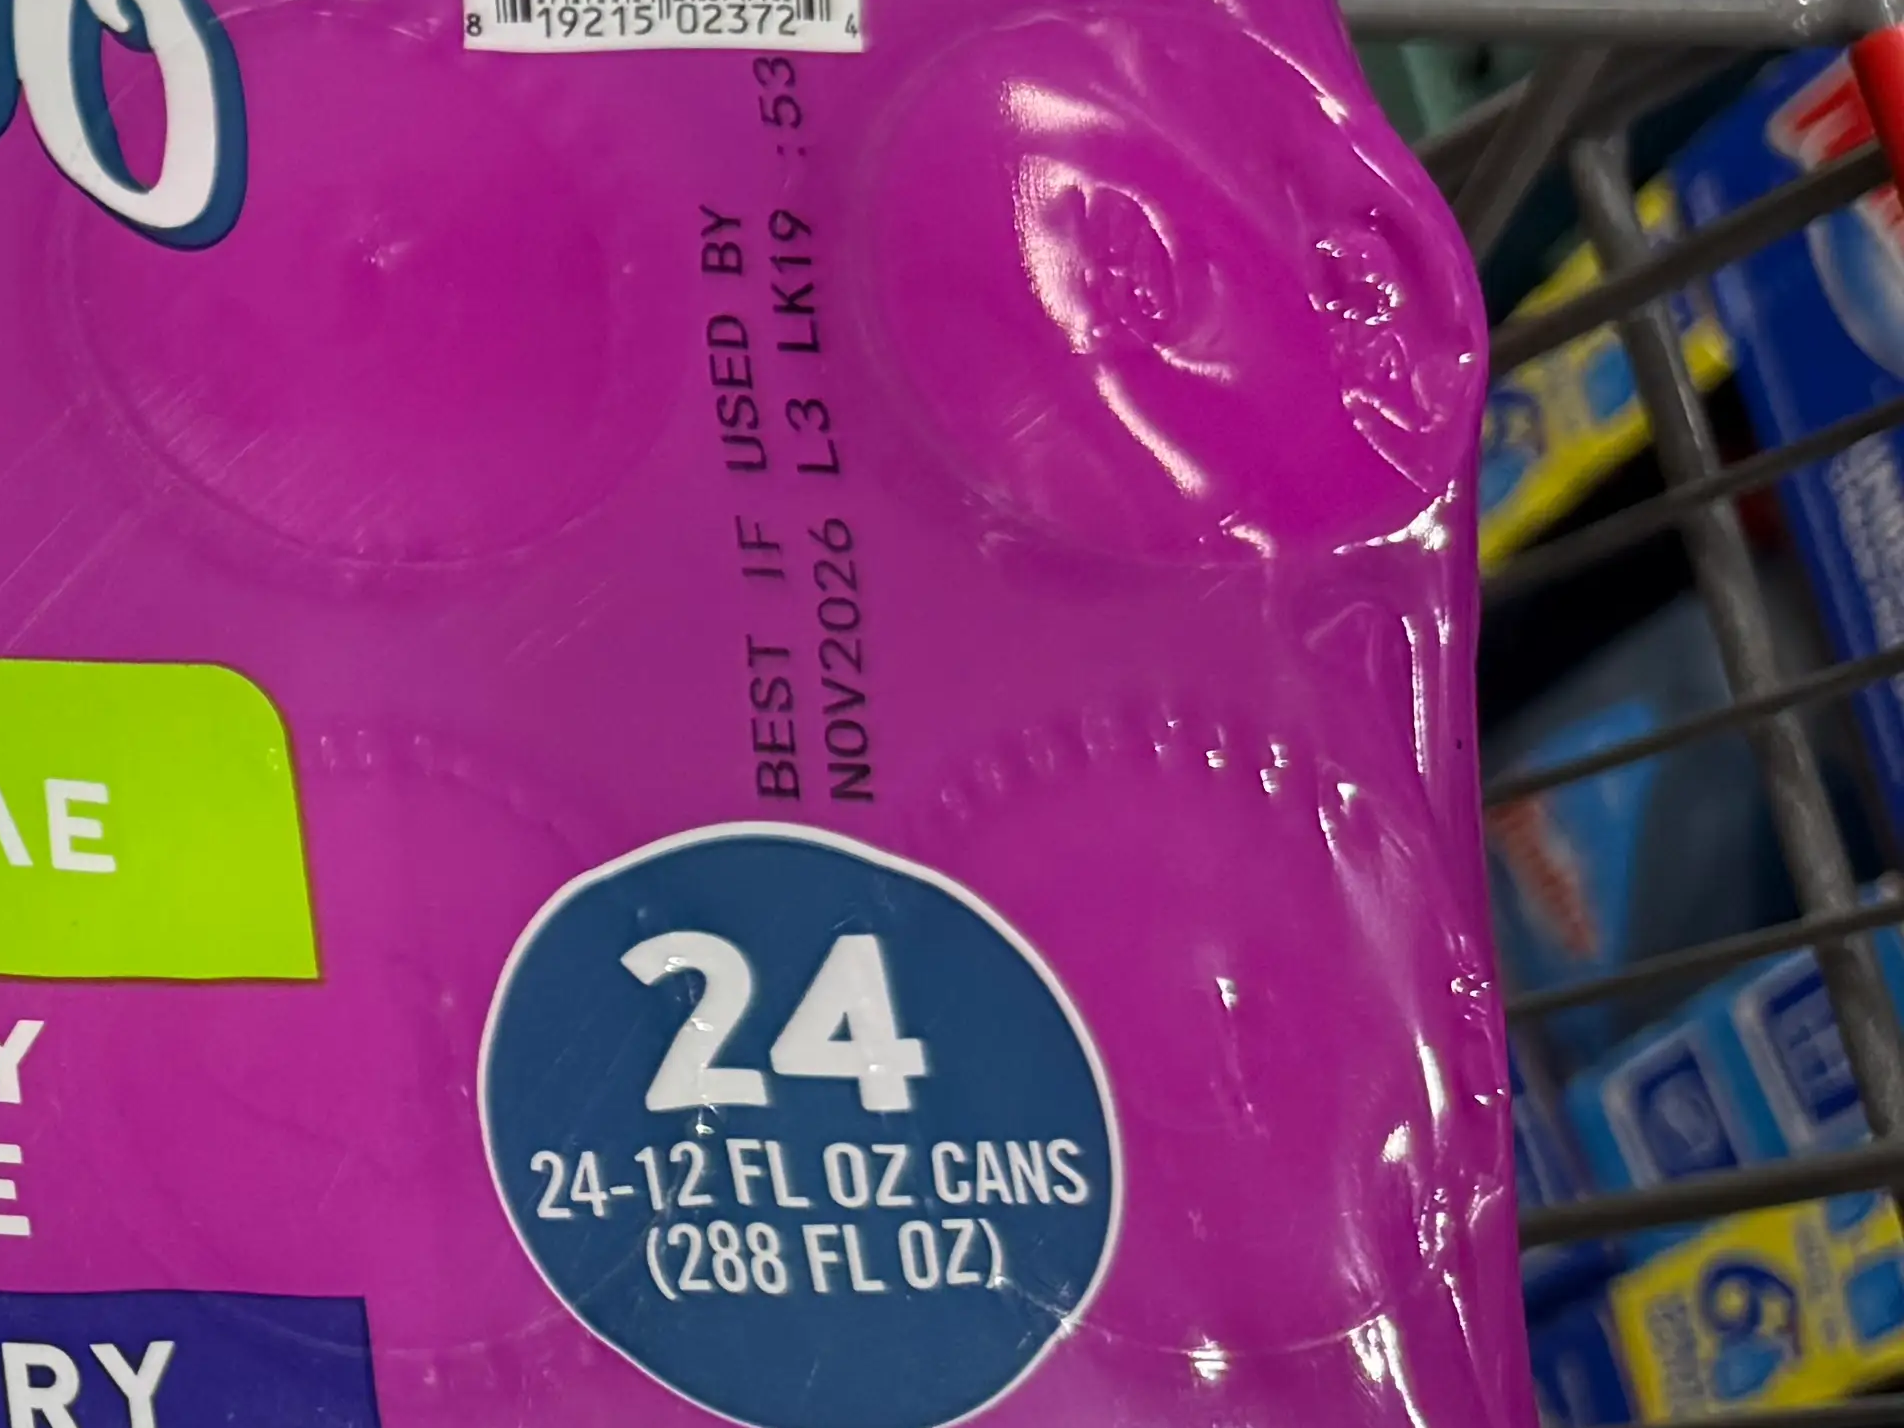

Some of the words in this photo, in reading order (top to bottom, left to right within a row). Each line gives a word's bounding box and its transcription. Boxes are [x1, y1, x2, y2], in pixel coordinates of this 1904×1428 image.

[466, 13, 483, 36] 8
[536, 4, 655, 38] 19215
[676, 3, 798, 36] 02372
[845, 15, 860, 37] 4
[699, 203, 745, 275] BY
[768, 208, 821, 355] LK19
[706, 313, 768, 473] USED
[785, 397, 842, 475] L3
[736, 514, 786, 580] IF
[808, 517, 875, 803] NOV2026
[746, 635, 801, 801] BEST
[620, 930, 927, 1113] 24
[529, 1139, 716, 1221] 24-12
[726, 1138, 810, 1209] FL
[823, 1142, 914, 1209] OZ
[930, 1138, 1090, 1206] CANS
[646, 1222, 789, 1302] (288
[803, 1223, 885, 1294] FL
[898, 1217, 1003, 1290] OZ)
